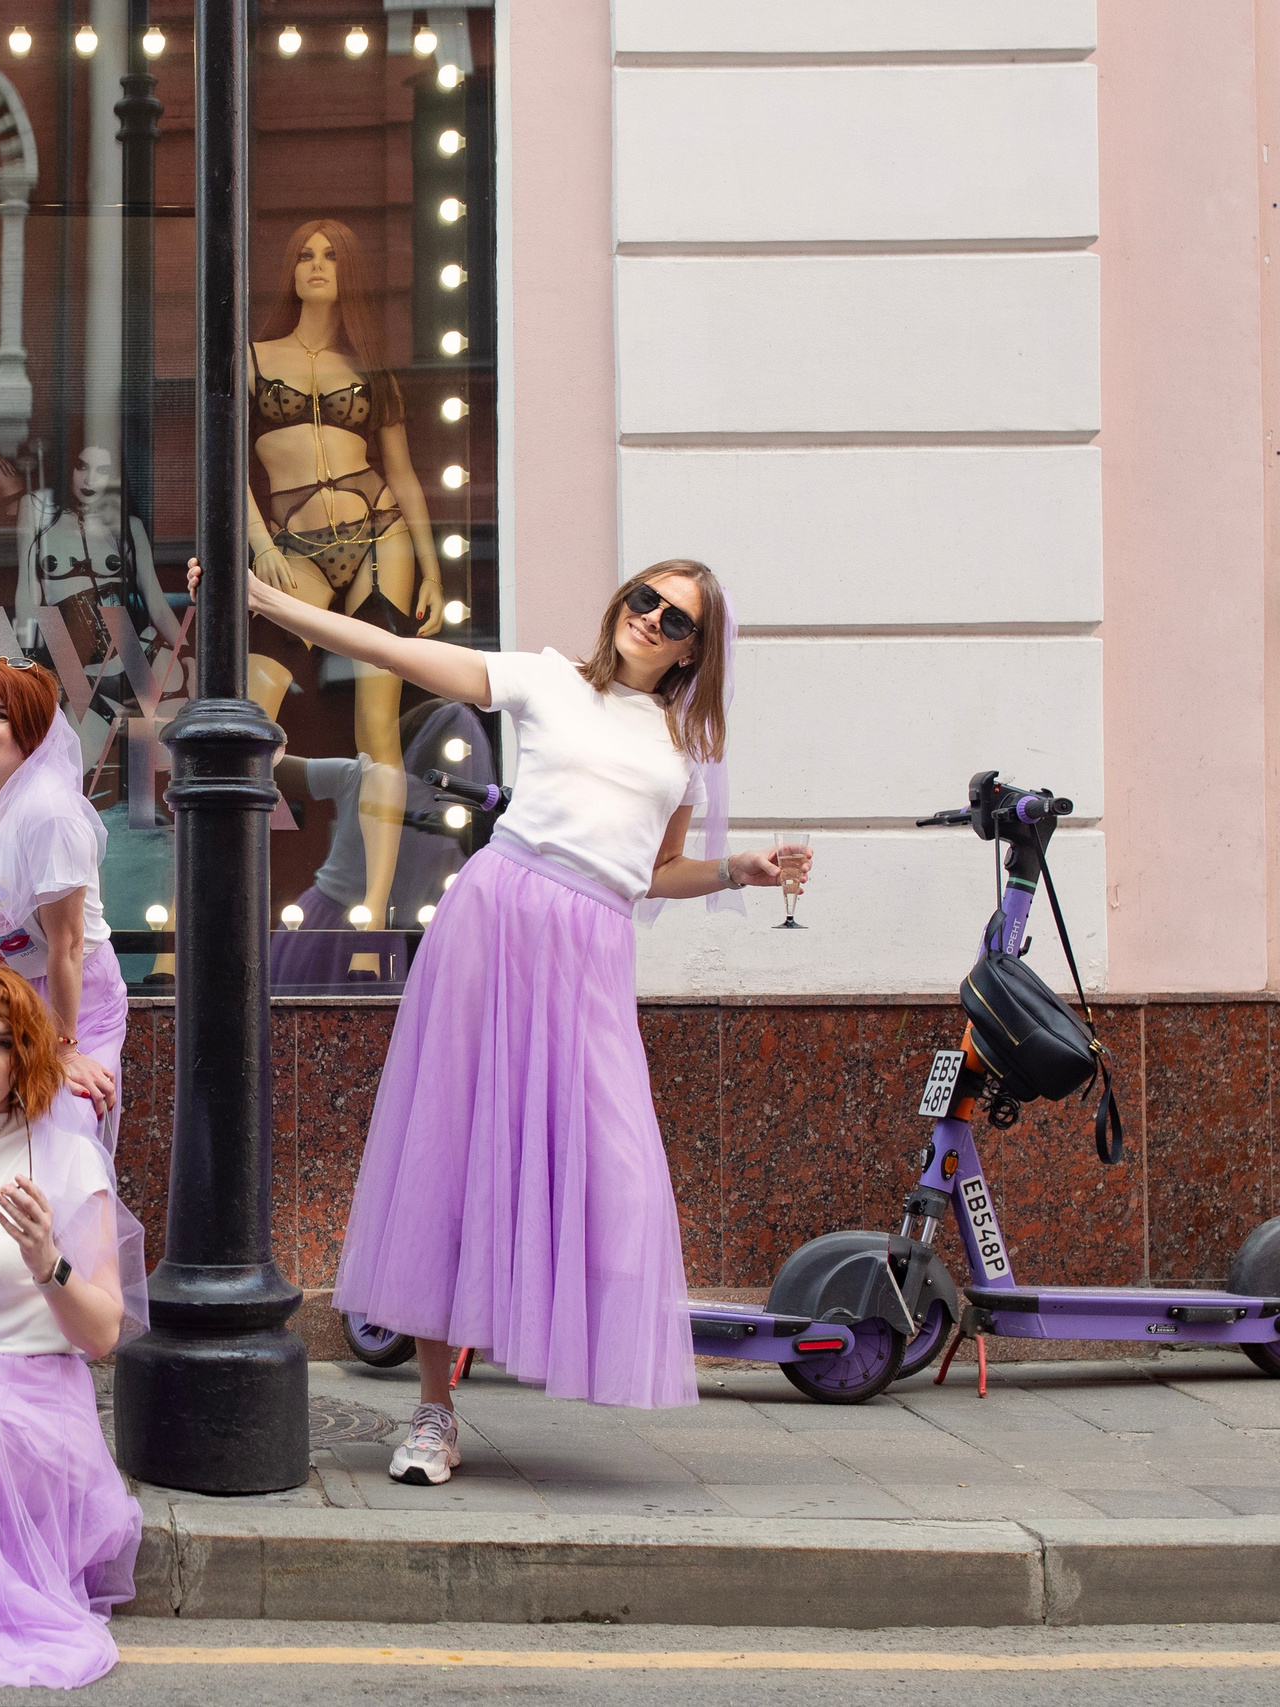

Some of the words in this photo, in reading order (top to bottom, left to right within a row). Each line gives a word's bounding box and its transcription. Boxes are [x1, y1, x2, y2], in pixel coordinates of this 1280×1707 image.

[930, 1056, 961, 1082] EB5
[923, 1085, 952, 1112] 48P
[963, 1180, 1005, 1271] EB548P
